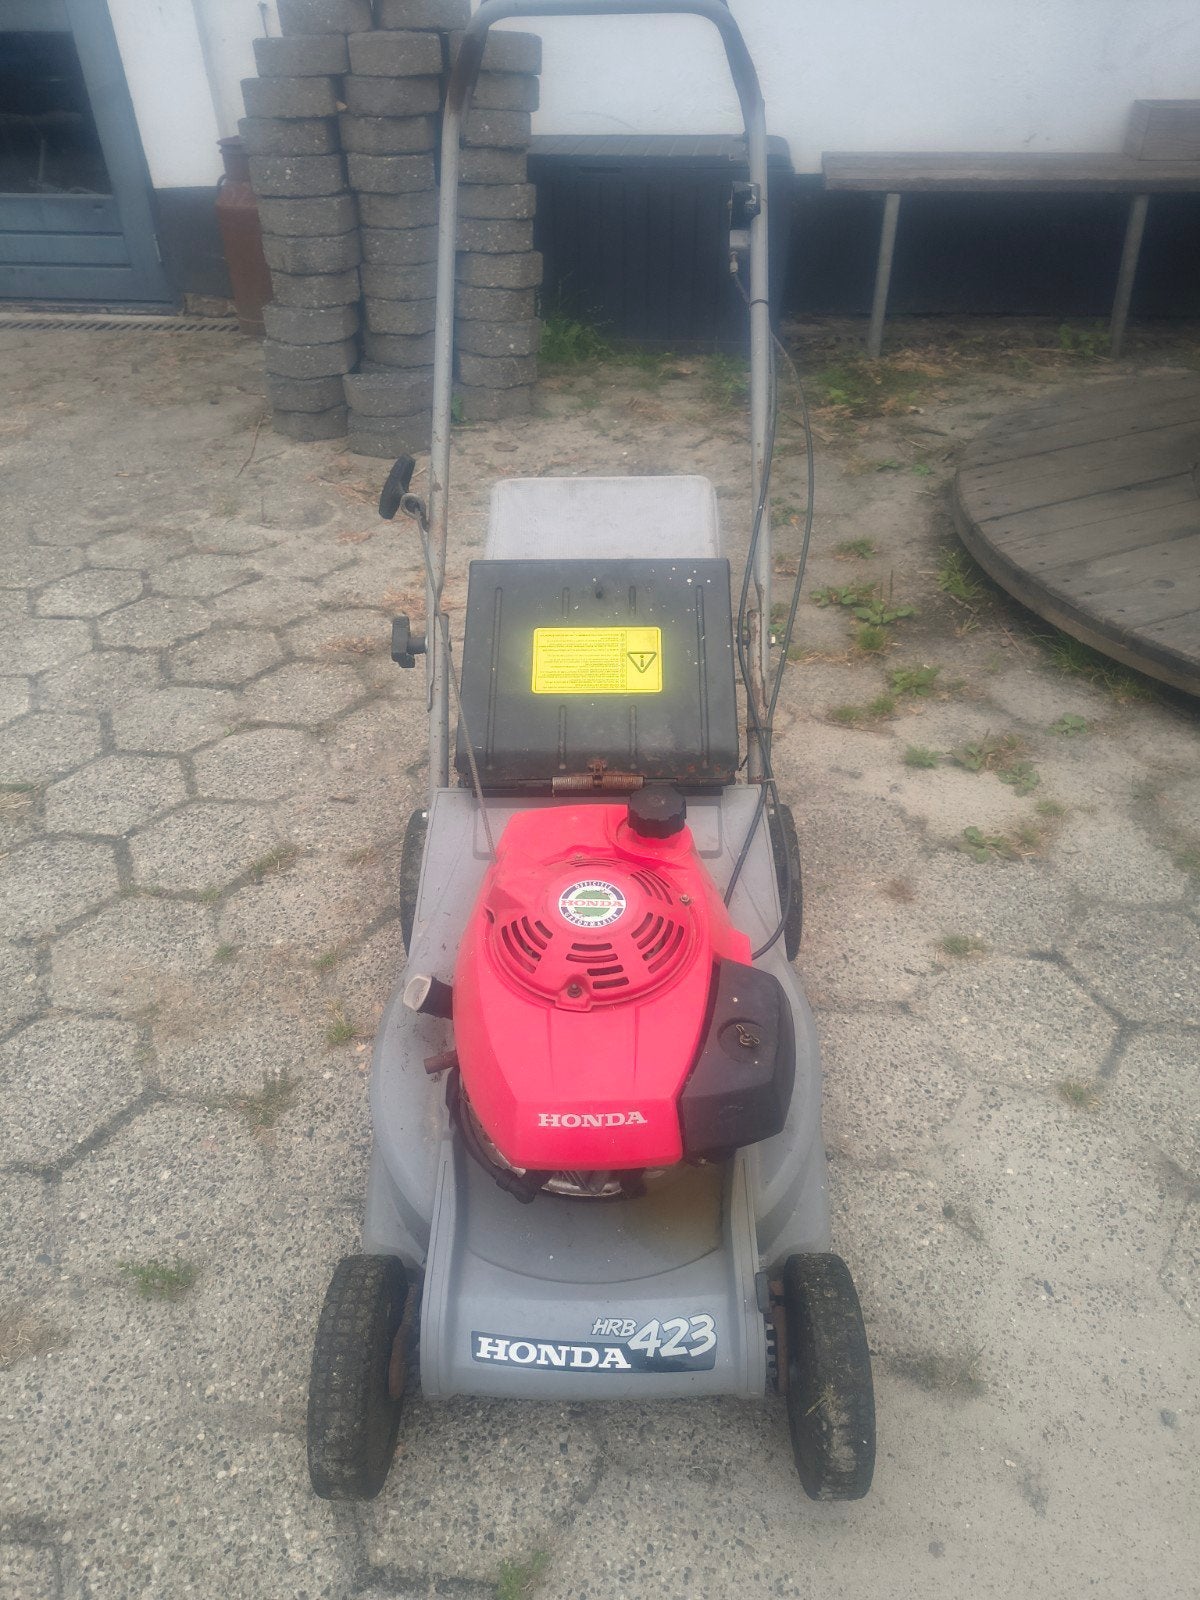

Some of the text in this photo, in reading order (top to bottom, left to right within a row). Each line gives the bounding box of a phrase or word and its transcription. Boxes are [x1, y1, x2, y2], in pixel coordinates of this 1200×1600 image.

[560, 899, 624, 907] HONDA
[538, 1111, 648, 1128] HONDA
[591, 1313, 718, 1357] HRB 423
[476, 1336, 631, 1369] HONDA
